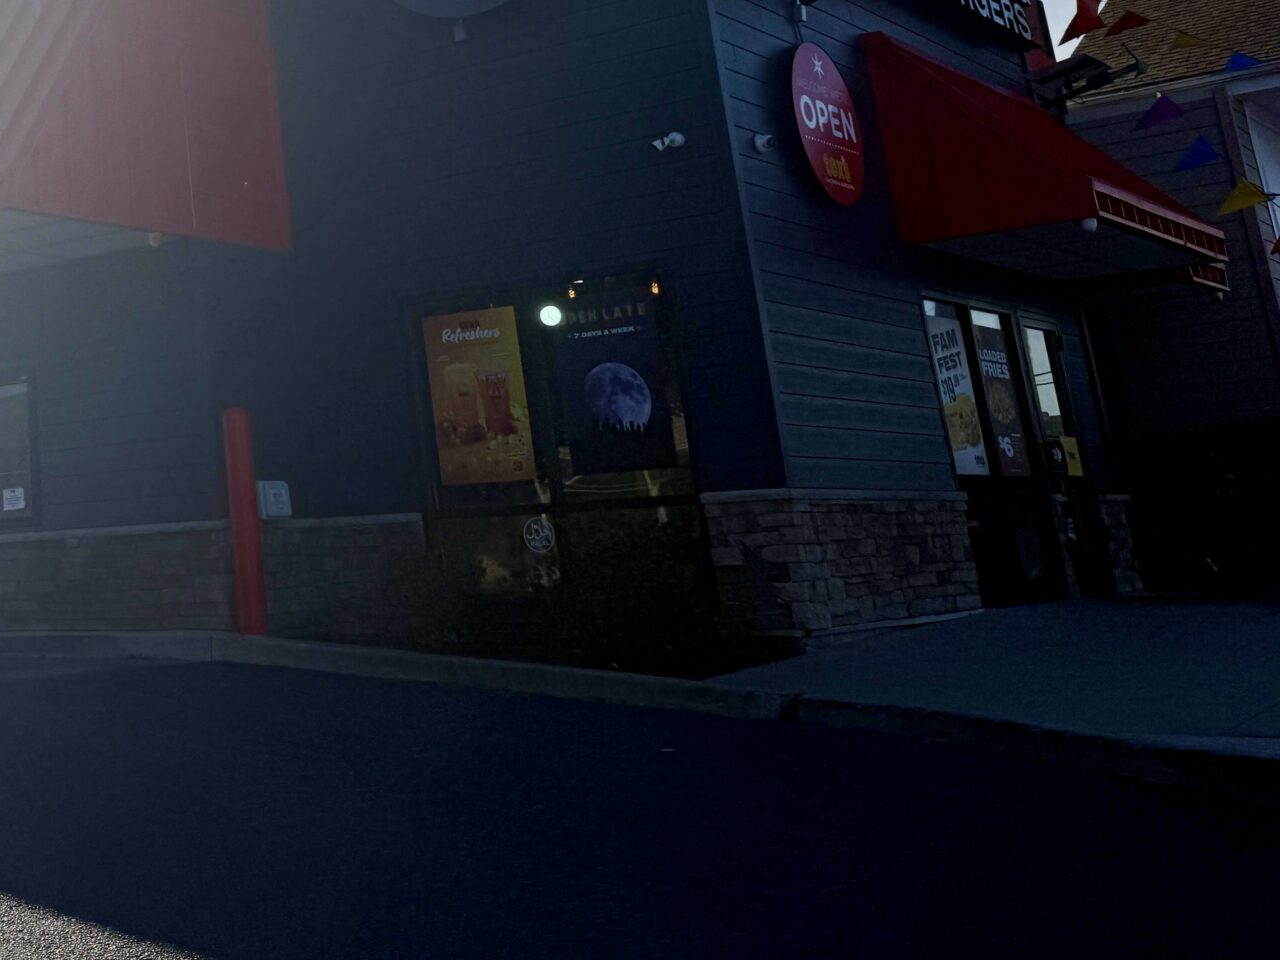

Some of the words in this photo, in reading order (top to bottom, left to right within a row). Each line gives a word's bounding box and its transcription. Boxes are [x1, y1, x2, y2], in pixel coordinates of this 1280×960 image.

[799, 94, 857, 144] OPEN
[602, 302, 646, 321] LATE
[441, 326, 500, 344] Refreshers
[581, 329, 602, 338] DAYS
[610, 325, 635, 335] WEEK
[931, 328, 958, 354] FAM
[936, 351, 962, 374] FEST
[980, 349, 1007, 362] LOADED
[982, 360, 1011, 380] FRIES
